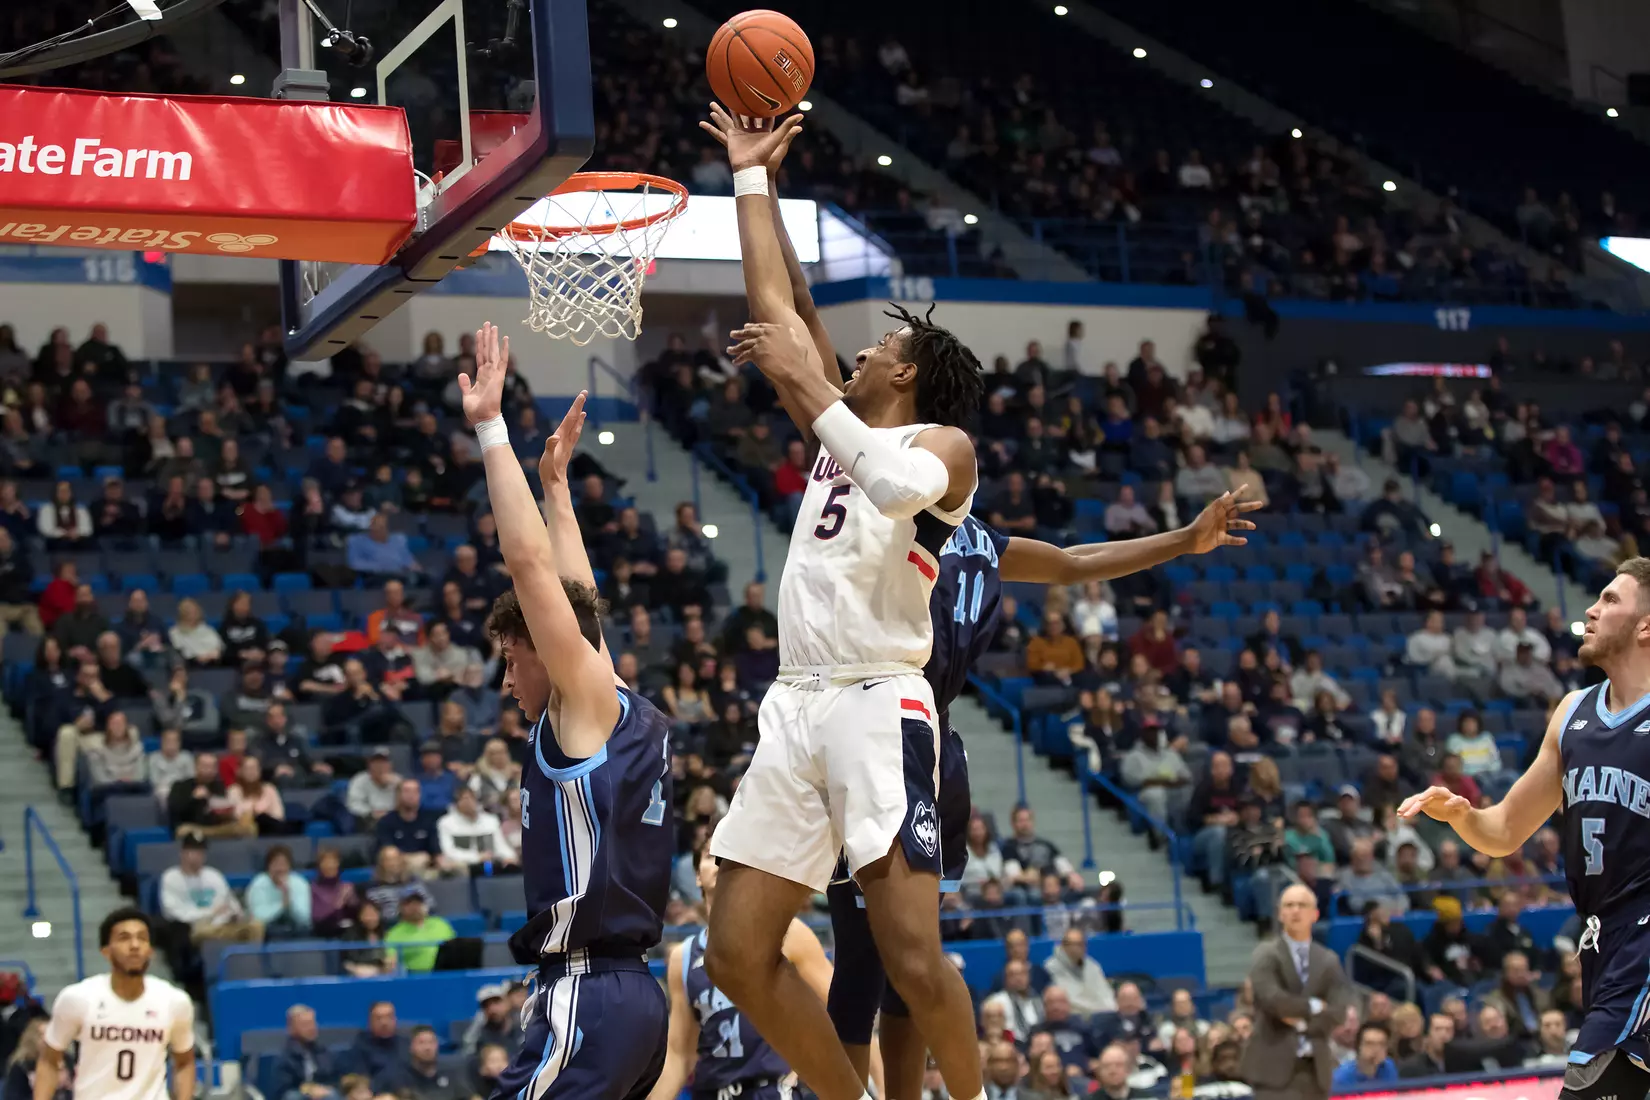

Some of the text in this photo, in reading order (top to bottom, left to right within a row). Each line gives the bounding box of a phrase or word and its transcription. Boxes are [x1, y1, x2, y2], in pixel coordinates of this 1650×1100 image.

[772, 49, 806, 92] ELITE
[887, 276, 936, 301] 116
[1434, 307, 1471, 331] 117
[813, 484, 851, 541] 5
[953, 569, 985, 626] 10
[1581, 817, 1606, 876] 5
[90, 1024, 164, 1043] UCONN
[116, 1048, 136, 1081] 0
